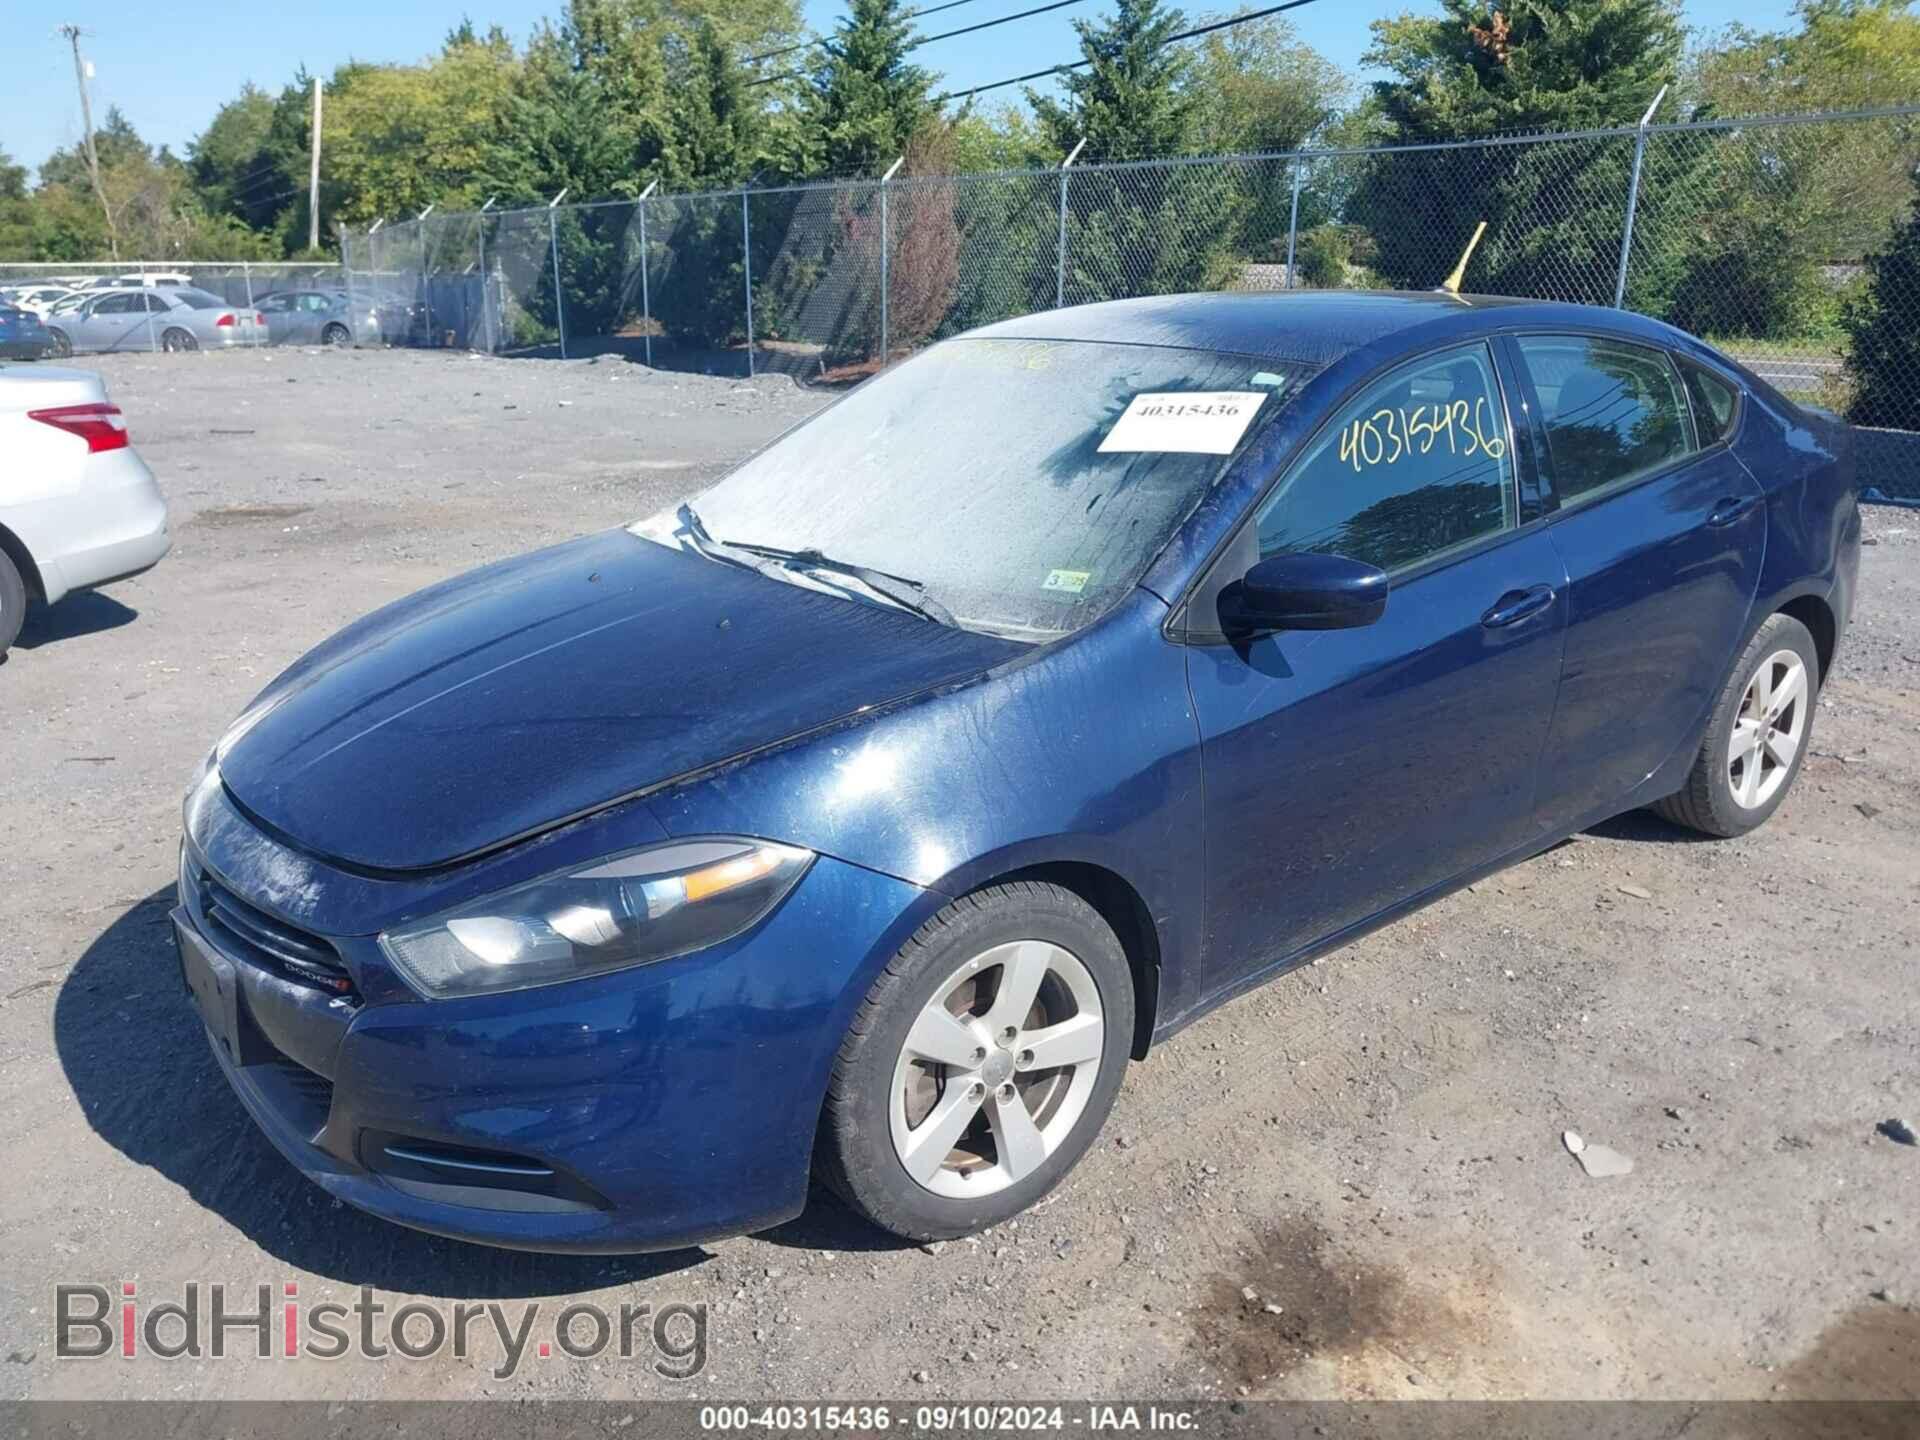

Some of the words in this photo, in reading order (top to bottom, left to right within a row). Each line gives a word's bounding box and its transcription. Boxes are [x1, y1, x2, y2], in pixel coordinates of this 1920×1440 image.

[1136, 404, 1239, 417] 40315436
[1340, 397, 1505, 472] 40315436
[284, 963, 336, 987] DODGE
